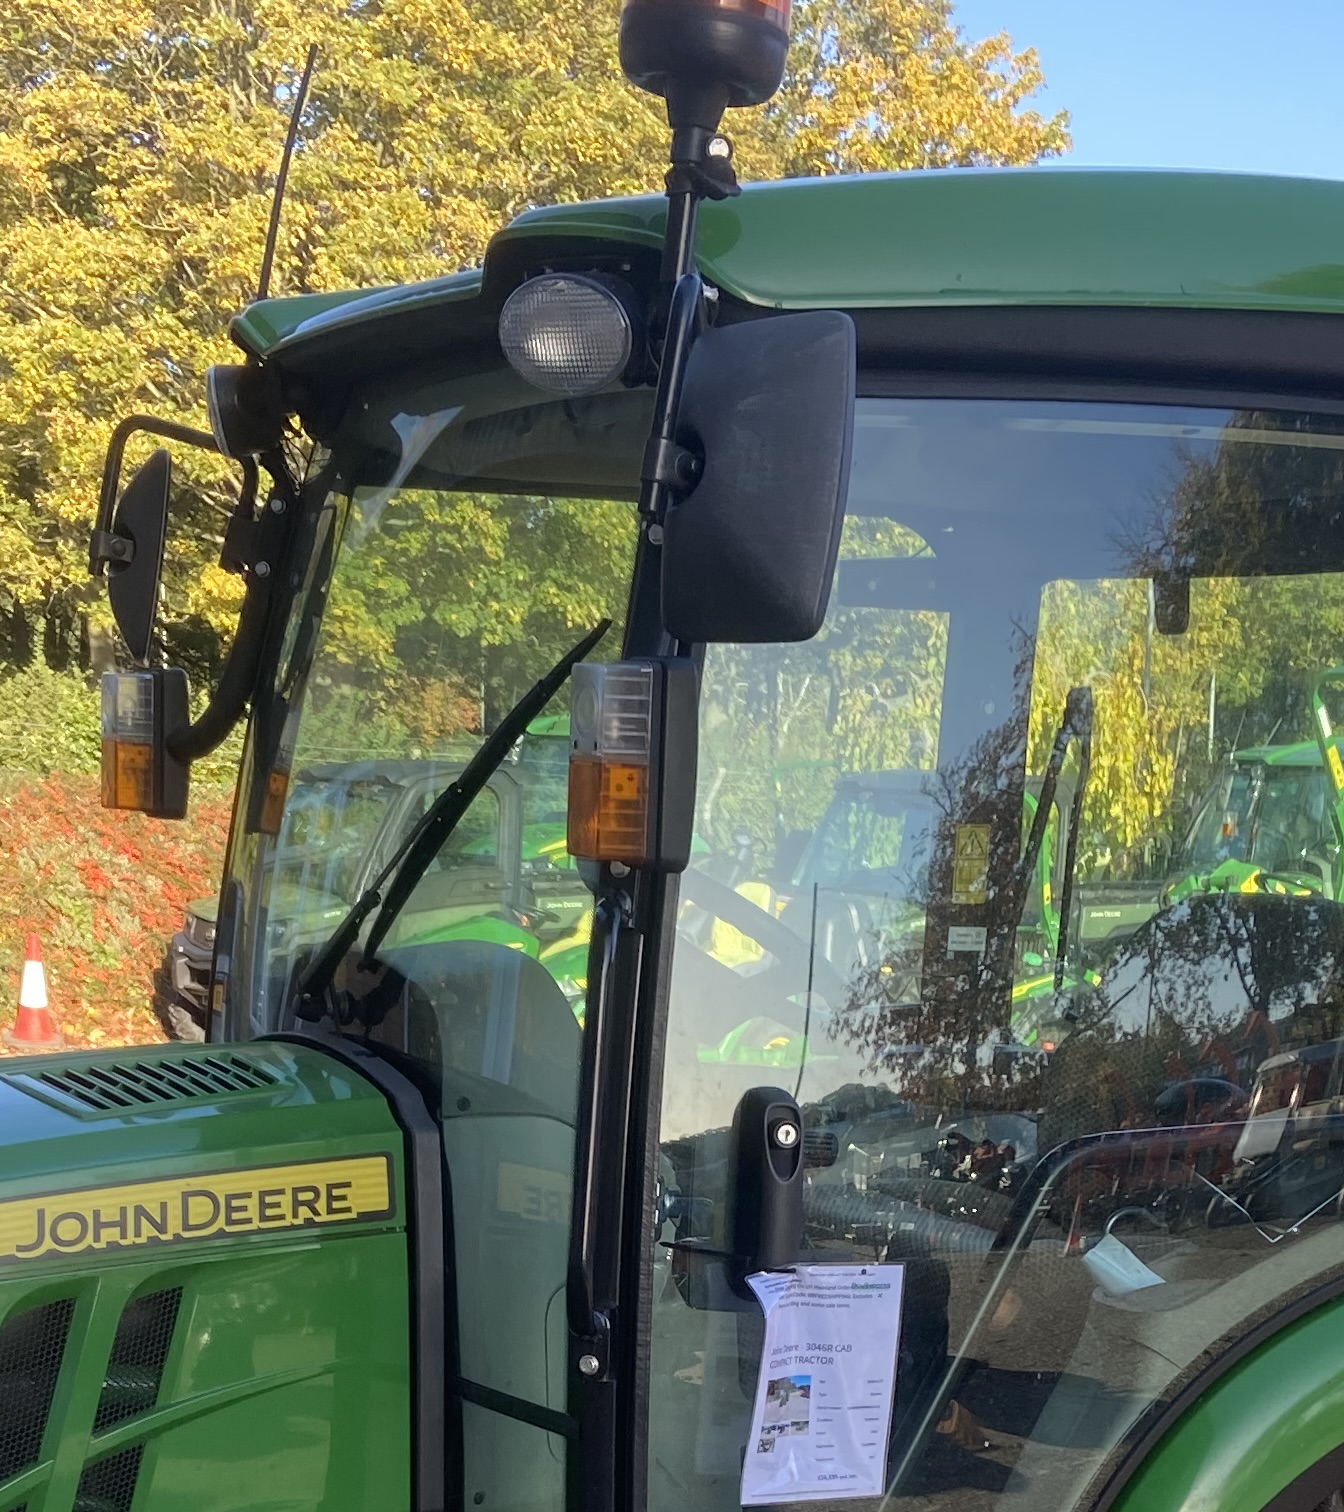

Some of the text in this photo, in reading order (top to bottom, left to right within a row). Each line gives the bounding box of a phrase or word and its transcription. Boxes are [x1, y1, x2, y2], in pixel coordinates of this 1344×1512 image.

[15, 1181, 353, 1254] JOHN DEERE
[834, 1344, 853, 1353] CAB
[794, 1355, 835, 1366] TRACTOR
